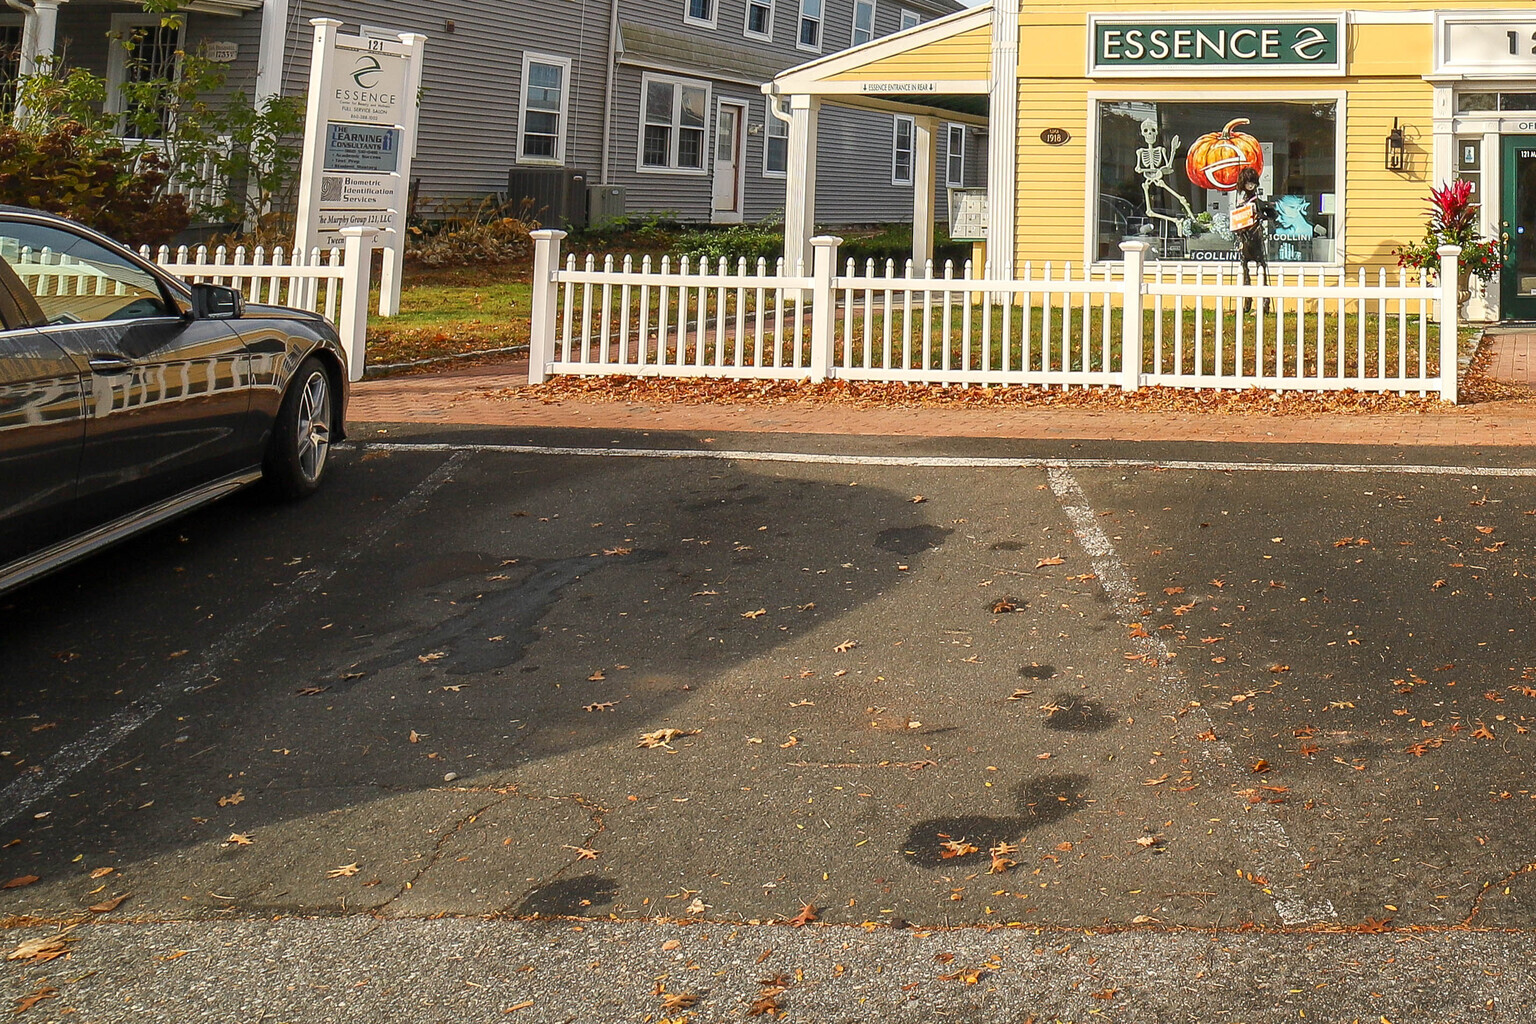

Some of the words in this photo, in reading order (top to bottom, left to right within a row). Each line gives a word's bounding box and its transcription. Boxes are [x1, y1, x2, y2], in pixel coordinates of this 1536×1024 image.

[368, 39, 384, 51] 121
[1103, 28, 1279, 60] ESSENCE
[868, 83, 887, 91] ESSENCE
[888, 83, 911, 91] ENTRANCE
[335, 89, 396, 105] ESSENCE
[333, 125, 348, 133] THE
[332, 132, 382, 143] LEARNING
[1047, 134, 1062, 143] 1918
[331, 140, 382, 150] CONSULTANTS
[1521, 150, 1530, 158] 121
[344, 177, 382, 186] Biometric
[343, 185, 394, 195] Identification
[343, 194, 377, 203] Services
[327, 215, 350, 226] Murphy
[350, 215, 367, 225] Group
[380, 215, 392, 223] LLC
